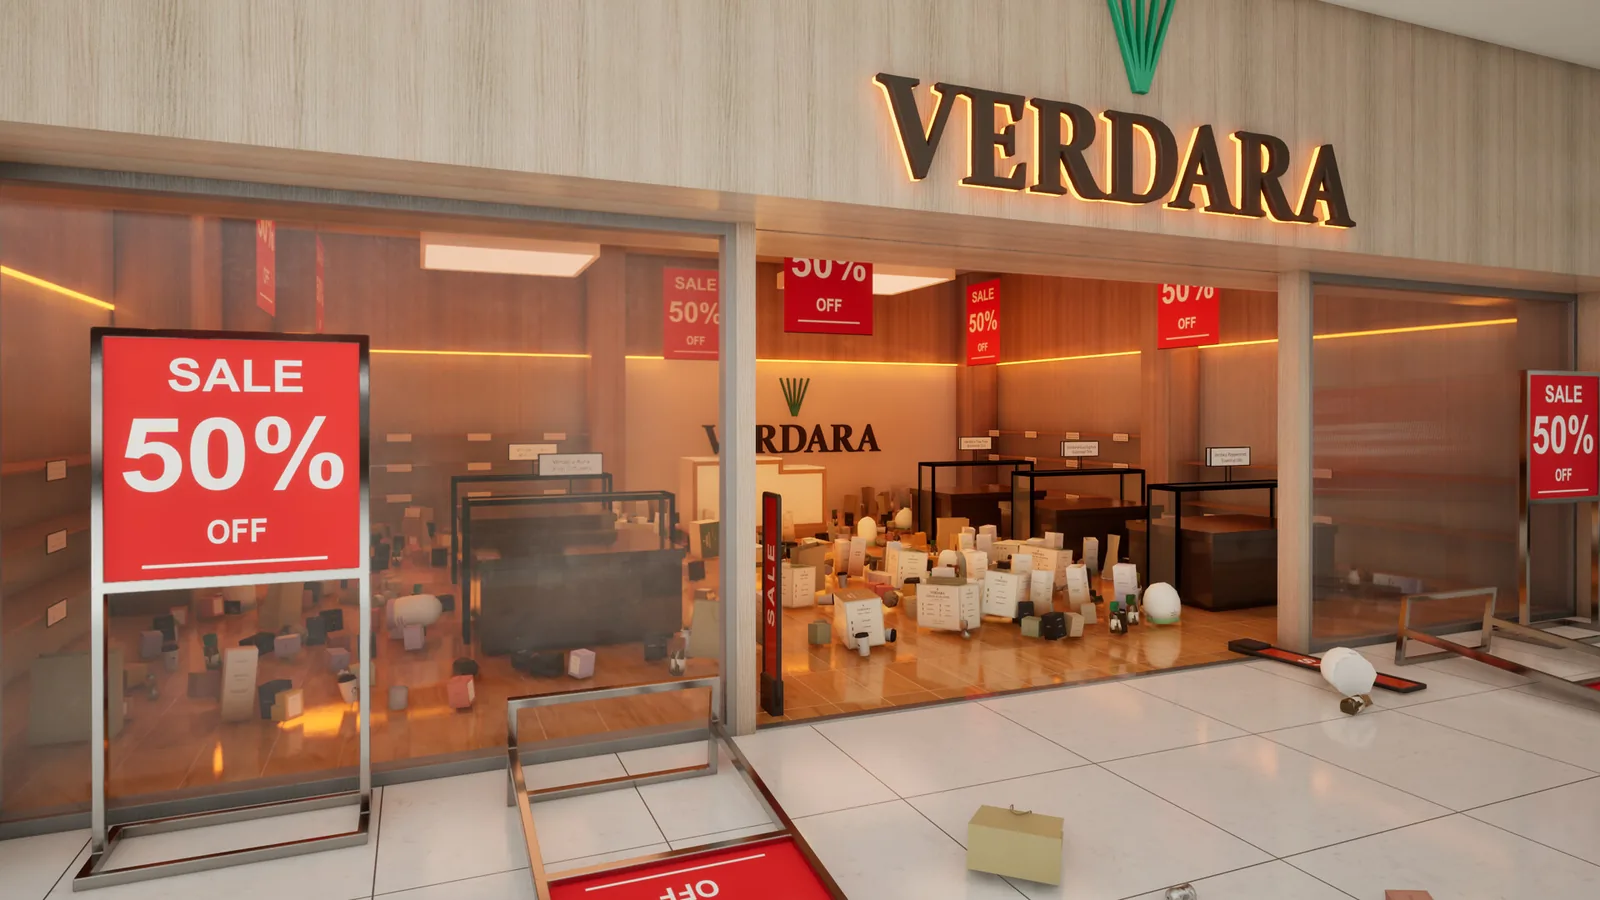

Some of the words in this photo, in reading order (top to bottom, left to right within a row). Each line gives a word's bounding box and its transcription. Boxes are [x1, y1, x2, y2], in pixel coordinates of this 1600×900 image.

[872, 72, 1357, 229] VERDARA
[791, 257, 867, 282] 50%
[674, 276, 718, 292] SALE
[971, 287, 996, 304] SALE
[668, 301, 720, 325] 50%
[816, 298, 843, 313] OFF
[968, 309, 999, 333] 50%
[1177, 316, 1197, 330] OFF
[686, 335, 706, 346] OFF
[977, 342, 989, 354] OFF
[167, 357, 304, 393] SALE
[1544, 384, 1583, 404] SALE
[702, 424, 882, 454] VRDARA
[1532, 414, 1594, 455] 50%
[122, 415, 345, 493] 50%
[1554, 467, 1573, 482] OFF
[206, 517, 268, 545] OFF
[766, 543, 776, 627] SALE
